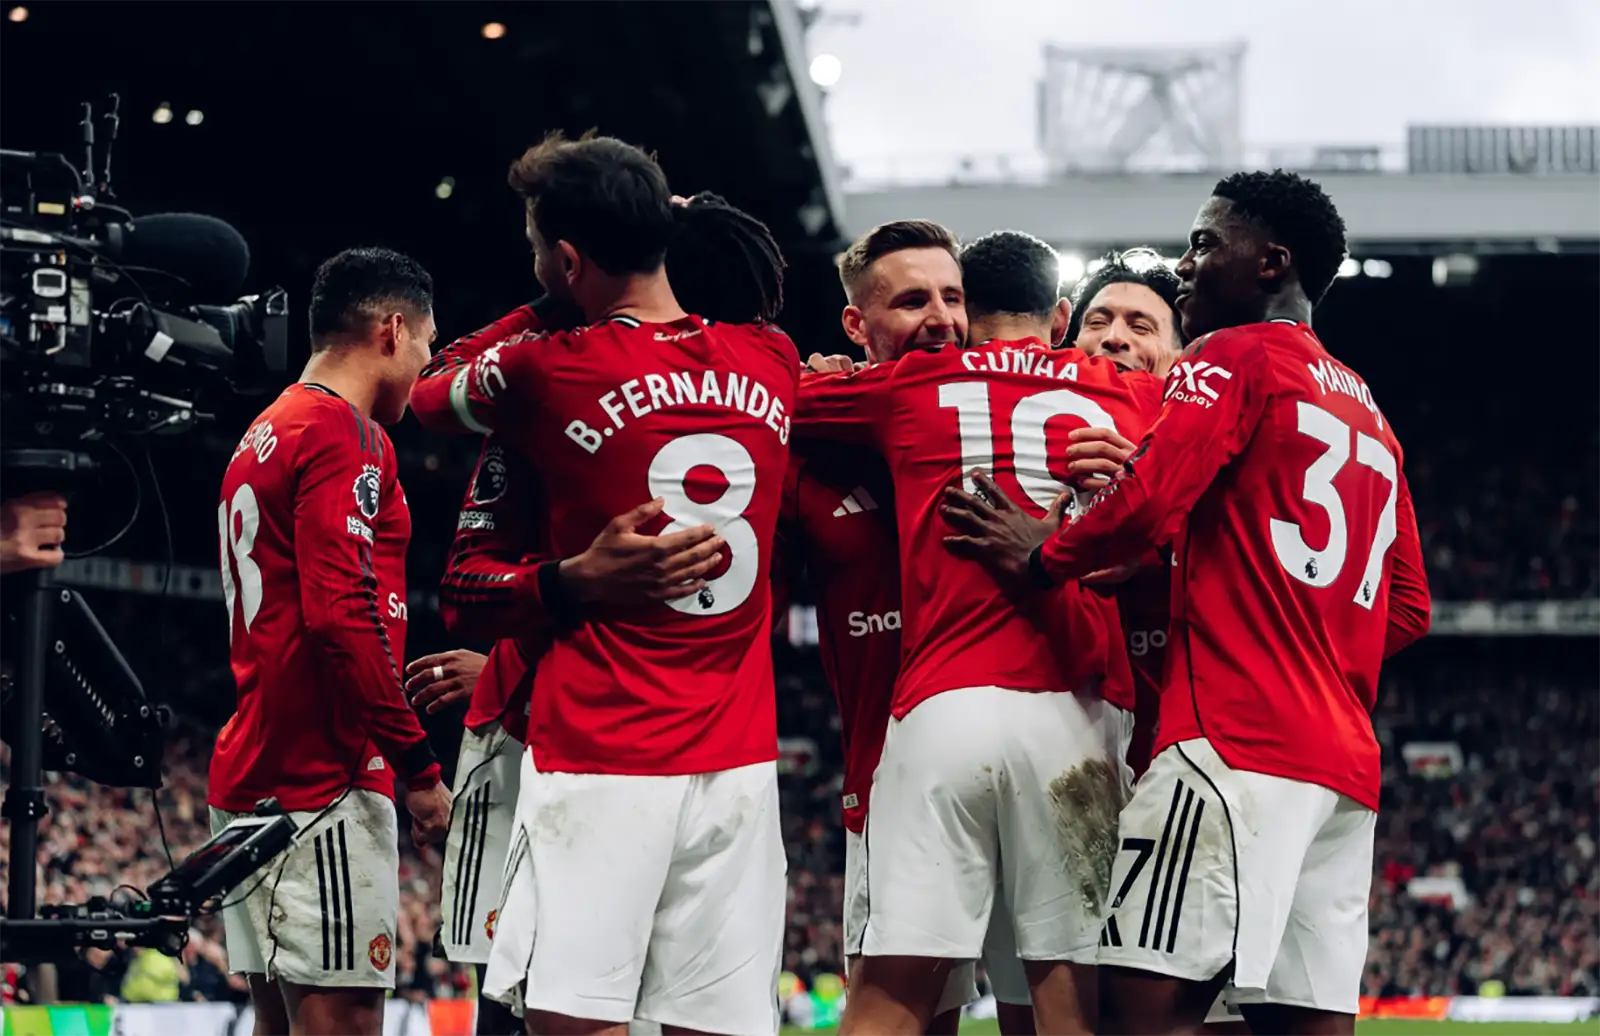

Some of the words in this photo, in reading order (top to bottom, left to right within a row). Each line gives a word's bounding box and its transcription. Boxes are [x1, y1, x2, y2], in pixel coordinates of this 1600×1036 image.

[564, 370, 791, 454] B.FERNANDES
[938, 381, 1117, 518] 10
[648, 432, 759, 616] 8
[1269, 400, 1398, 611] 37
[1111, 838, 1156, 908] 7
